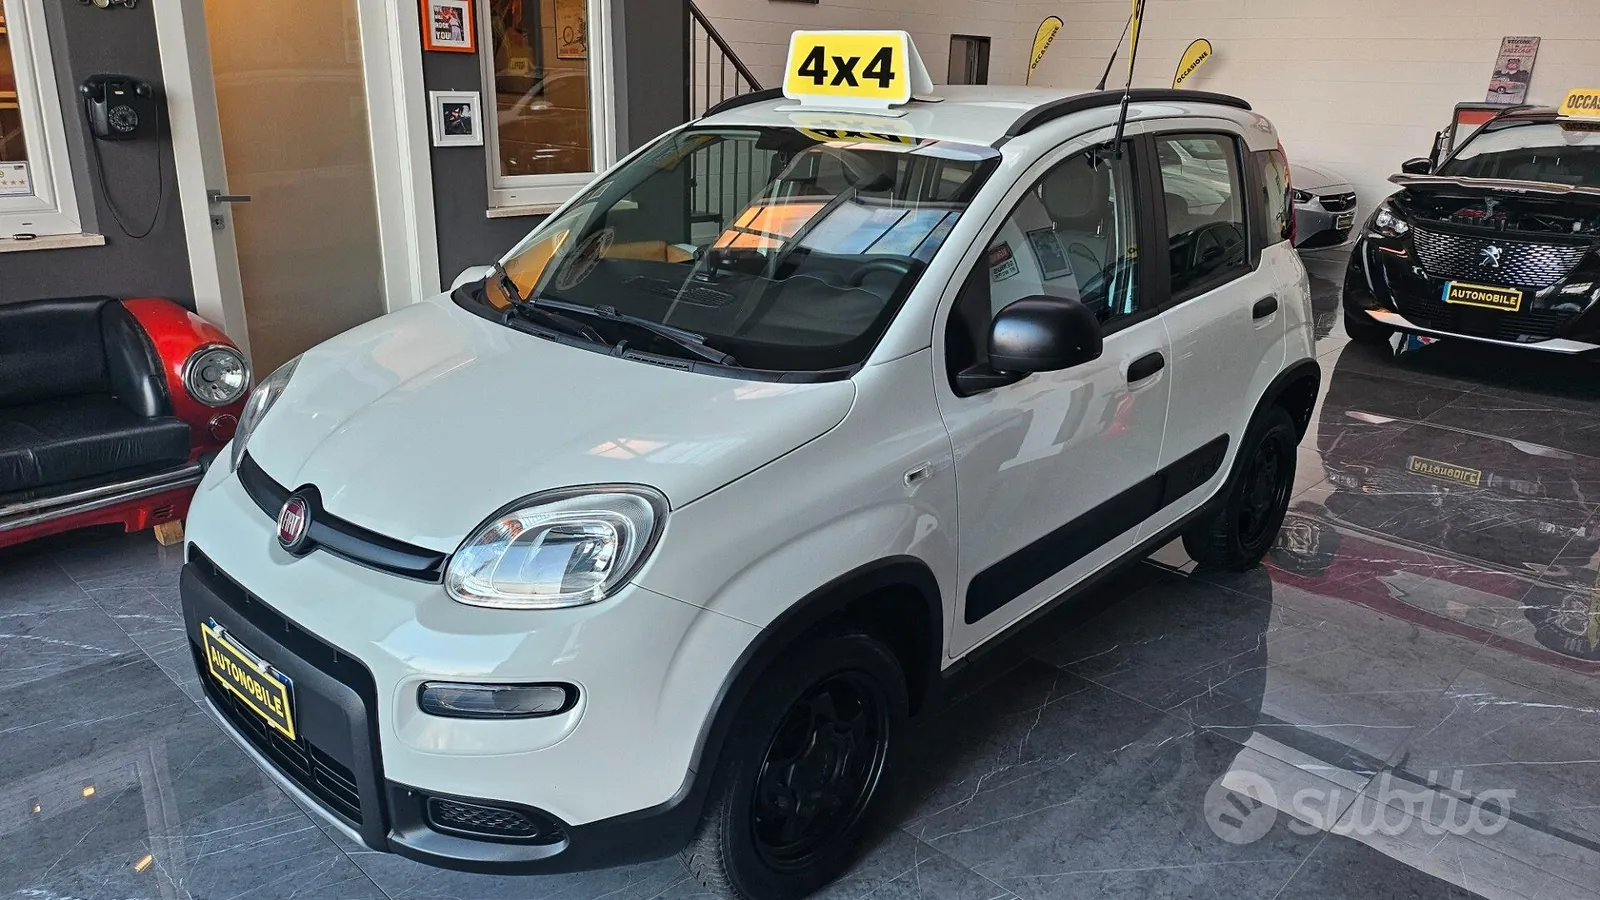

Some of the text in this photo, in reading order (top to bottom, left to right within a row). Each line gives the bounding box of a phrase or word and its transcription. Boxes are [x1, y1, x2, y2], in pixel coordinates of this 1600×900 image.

[436, 31, 450, 39] YOU
[1031, 26, 1060, 69] OCCASIONE
[797, 45, 896, 88] 4x4
[1176, 51, 1208, 83] OCCASIONE
[1450, 288, 1518, 306] AUTONOBILE
[281, 509, 301, 536] FIAT
